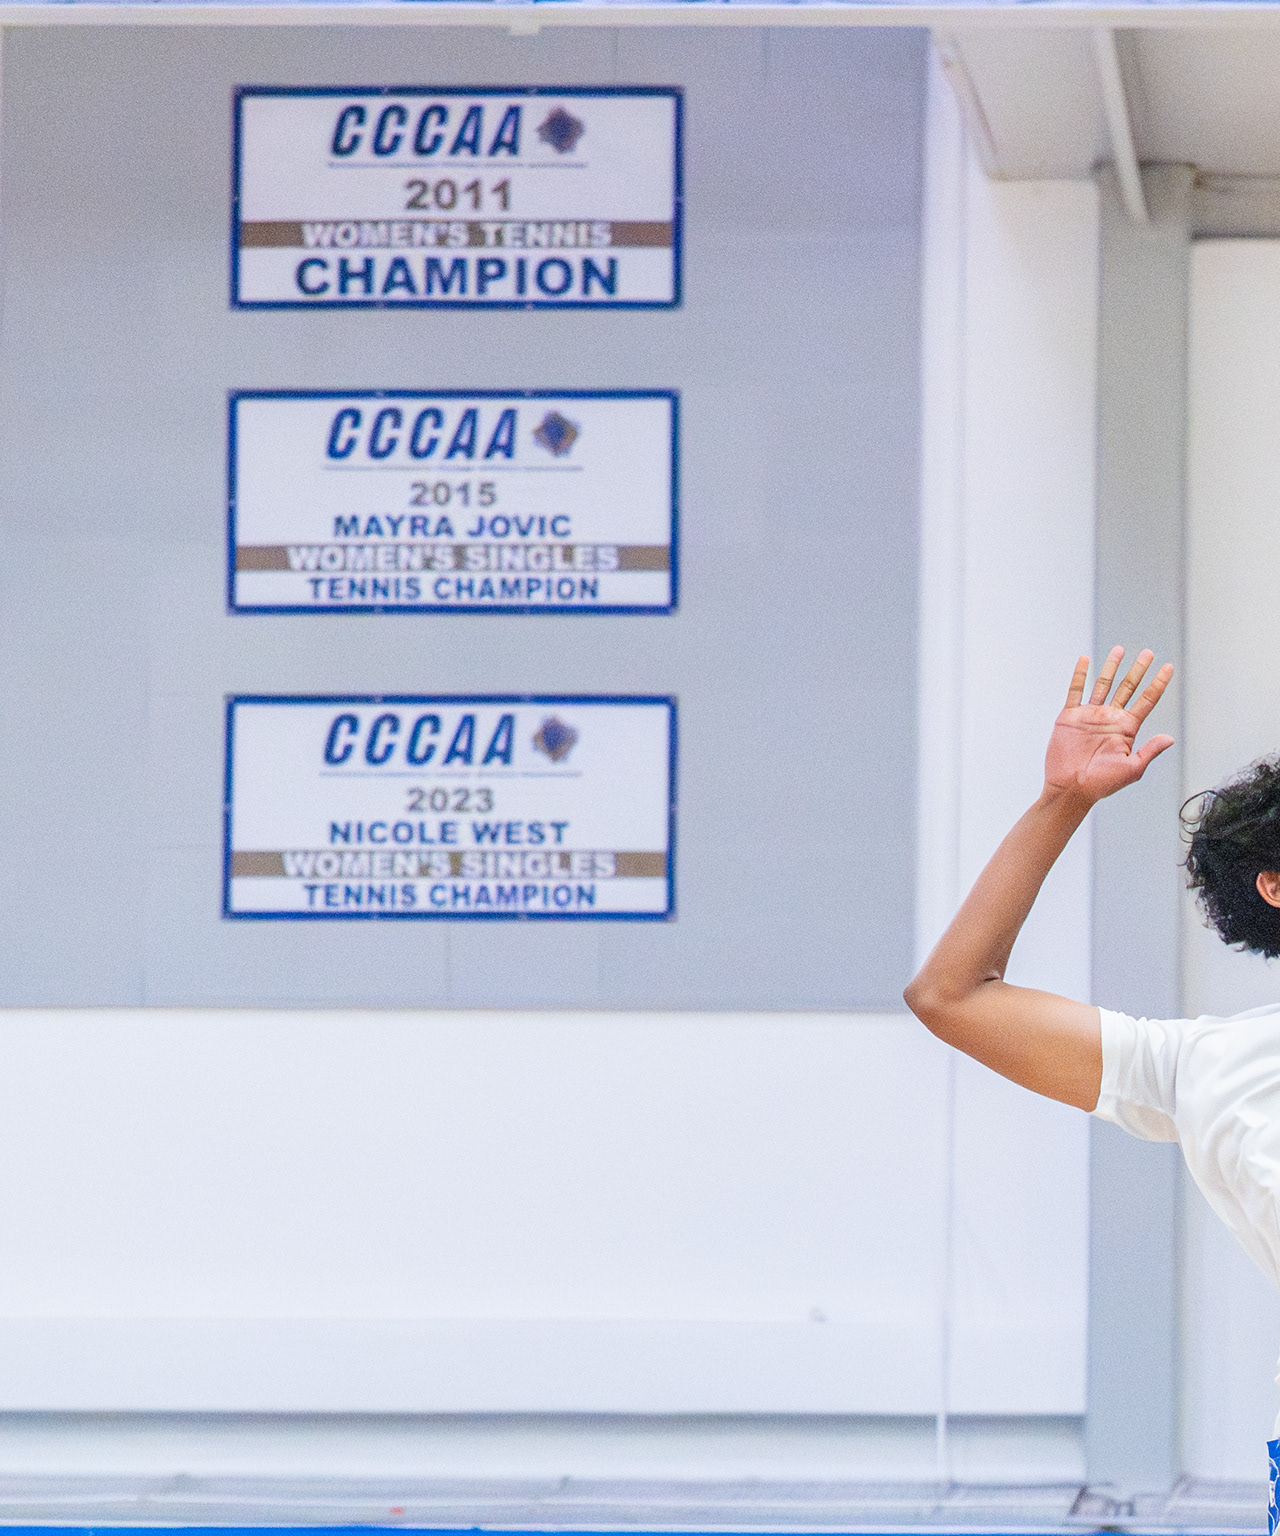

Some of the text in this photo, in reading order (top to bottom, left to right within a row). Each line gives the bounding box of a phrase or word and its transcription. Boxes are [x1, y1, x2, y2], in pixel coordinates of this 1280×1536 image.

[330, 103, 524, 158] CCCAA
[404, 178, 513, 213] 2011
[301, 221, 612, 248] WOMEN'S TENNIS
[294, 256, 620, 296] CHAMPION
[325, 407, 519, 461] CCCAA
[409, 481, 497, 508] 2015
[334, 515, 572, 539] MAYRA JOVIC
[286, 545, 620, 572] WOMEN'S SINGLES
[308, 577, 600, 601] TENNIS CHAMPION
[323, 712, 517, 767] CCCAA
[405, 787, 495, 814] 2023
[329, 820, 571, 846] NICOLE WEST
[282, 852, 617, 879] WOMEN'S SINGLES
[303, 883, 598, 909] TENNIS CHAMPION
